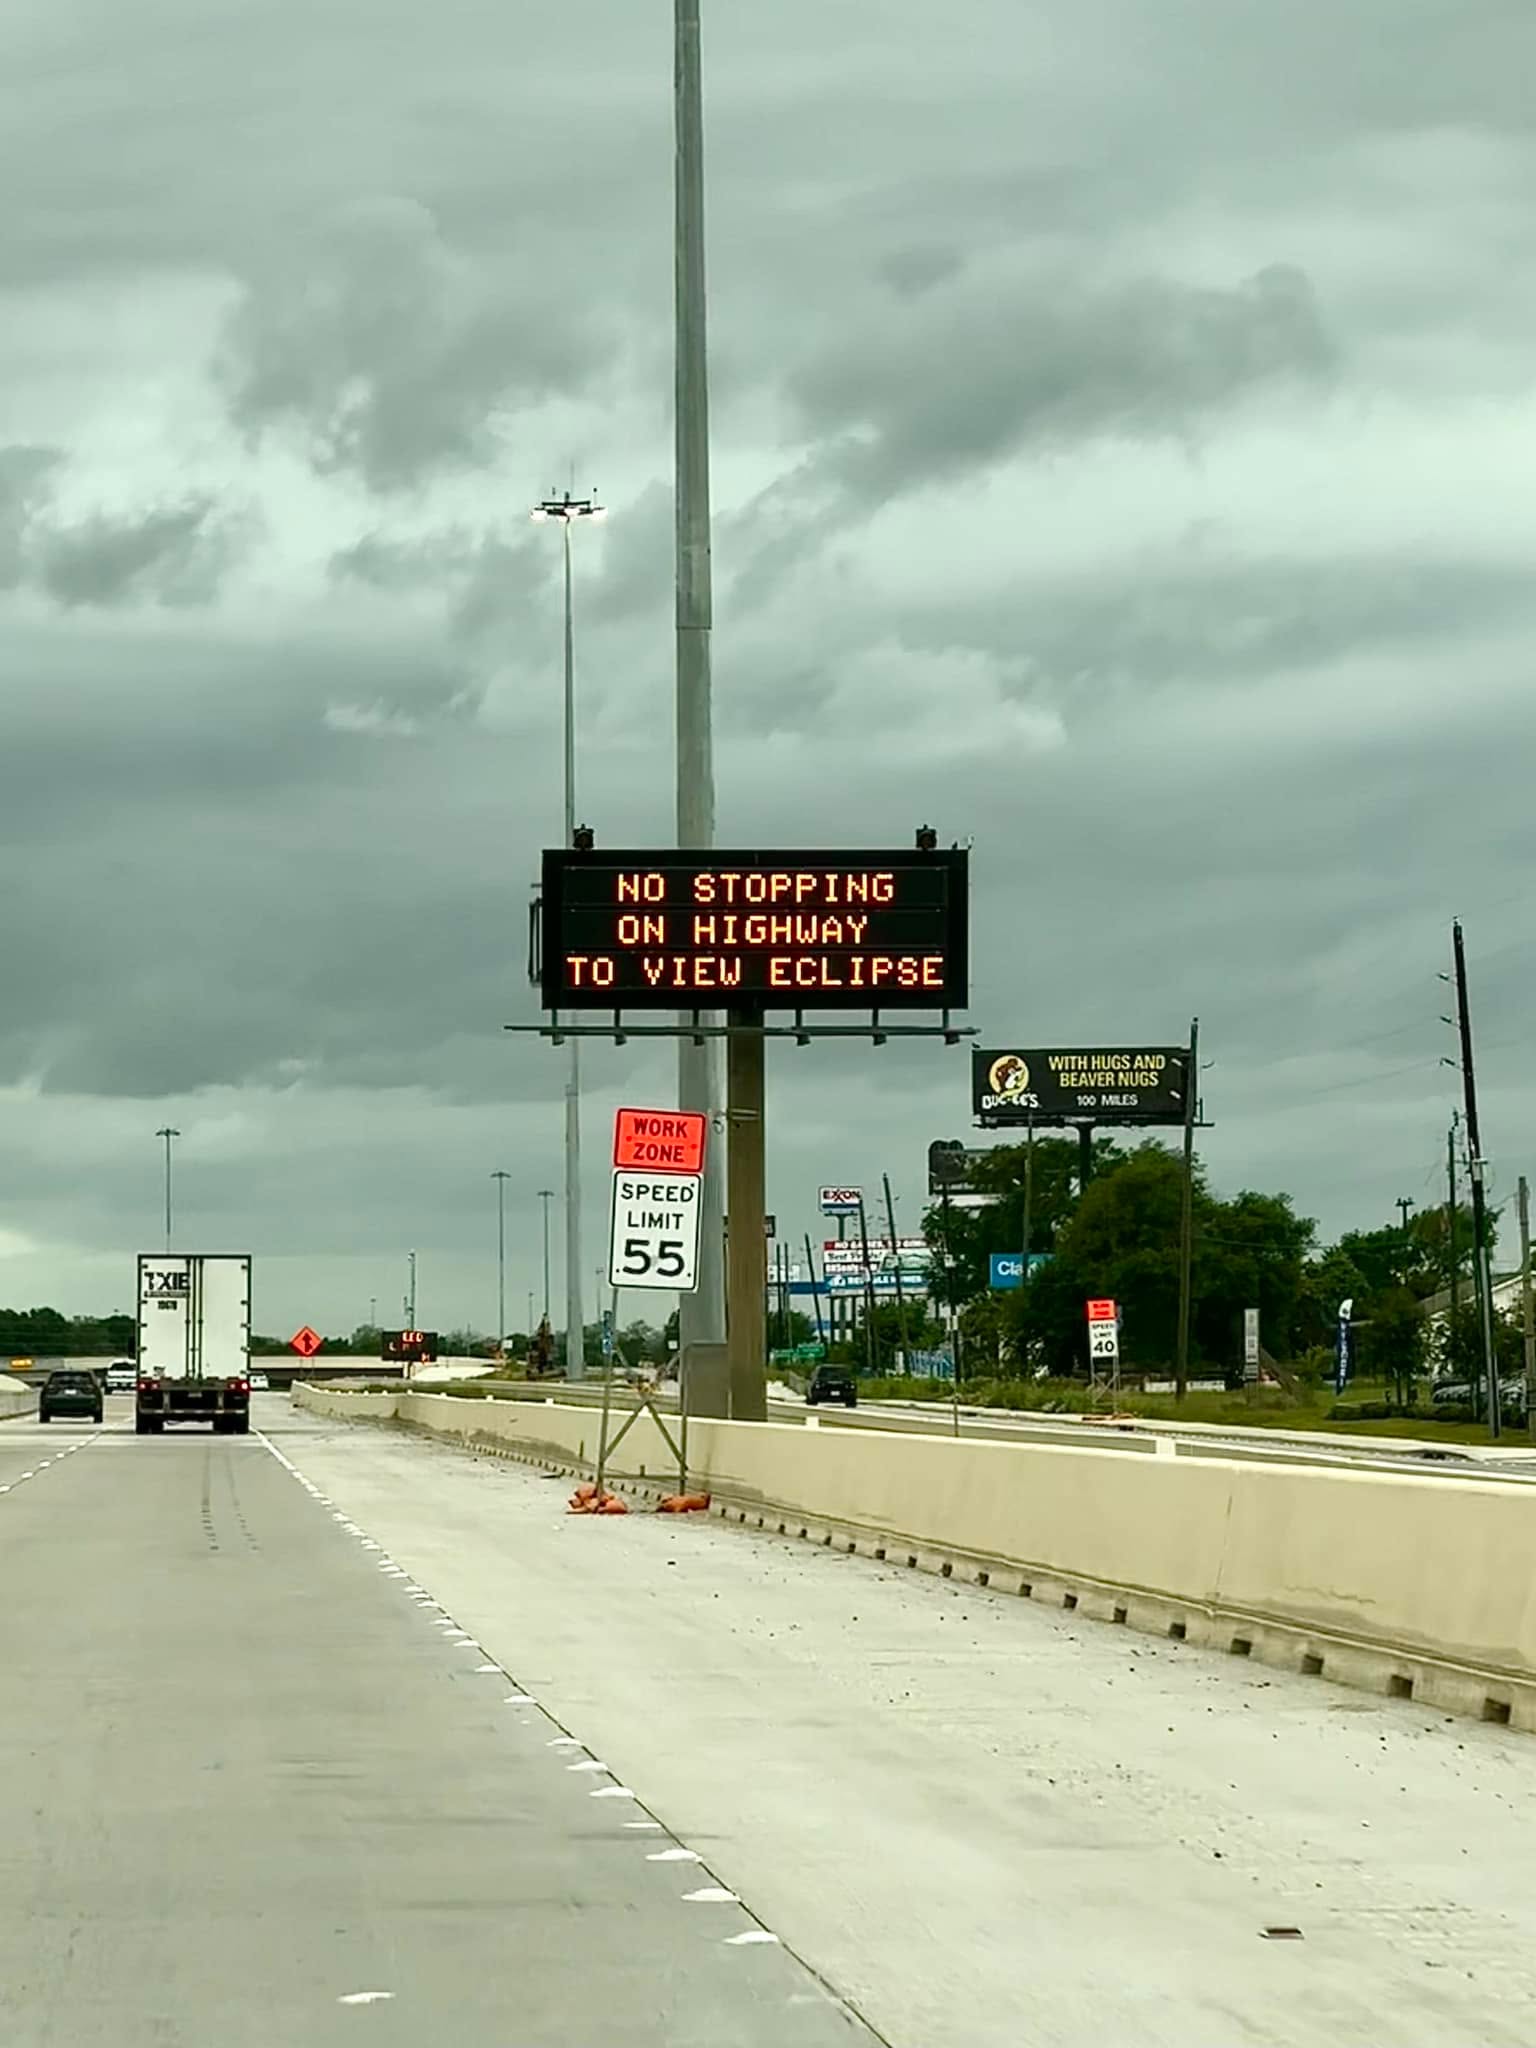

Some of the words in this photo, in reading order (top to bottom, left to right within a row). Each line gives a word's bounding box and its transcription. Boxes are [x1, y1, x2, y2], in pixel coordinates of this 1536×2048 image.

[617, 873, 665, 902] NO
[694, 873, 894, 902] STOPPING
[617, 915, 664, 944] ON
[694, 915, 867, 944] HIGHWAY
[566, 957, 614, 985] TO
[643, 957, 741, 985] VIEW
[770, 957, 944, 985] ECLIPSE
[1049, 1055, 1089, 1070] WITH
[1091, 1055, 1131, 1070] HUGS
[1133, 1055, 1165, 1070] AND
[1060, 1072, 1115, 1087] BEAVER
[1118, 1072, 1159, 1087] NUGS
[1077, 1095, 1096, 1107] 100
[1101, 1094, 1138, 1106] MILES
[633, 1117, 688, 1138] WORK
[633, 1142, 685, 1163] ZONE
[621, 1183, 694, 1202] SPEED
[627, 1211, 684, 1230] LIMIT
[622, 1238, 685, 1277] 55
[1094, 1340, 1114, 1352] 40
